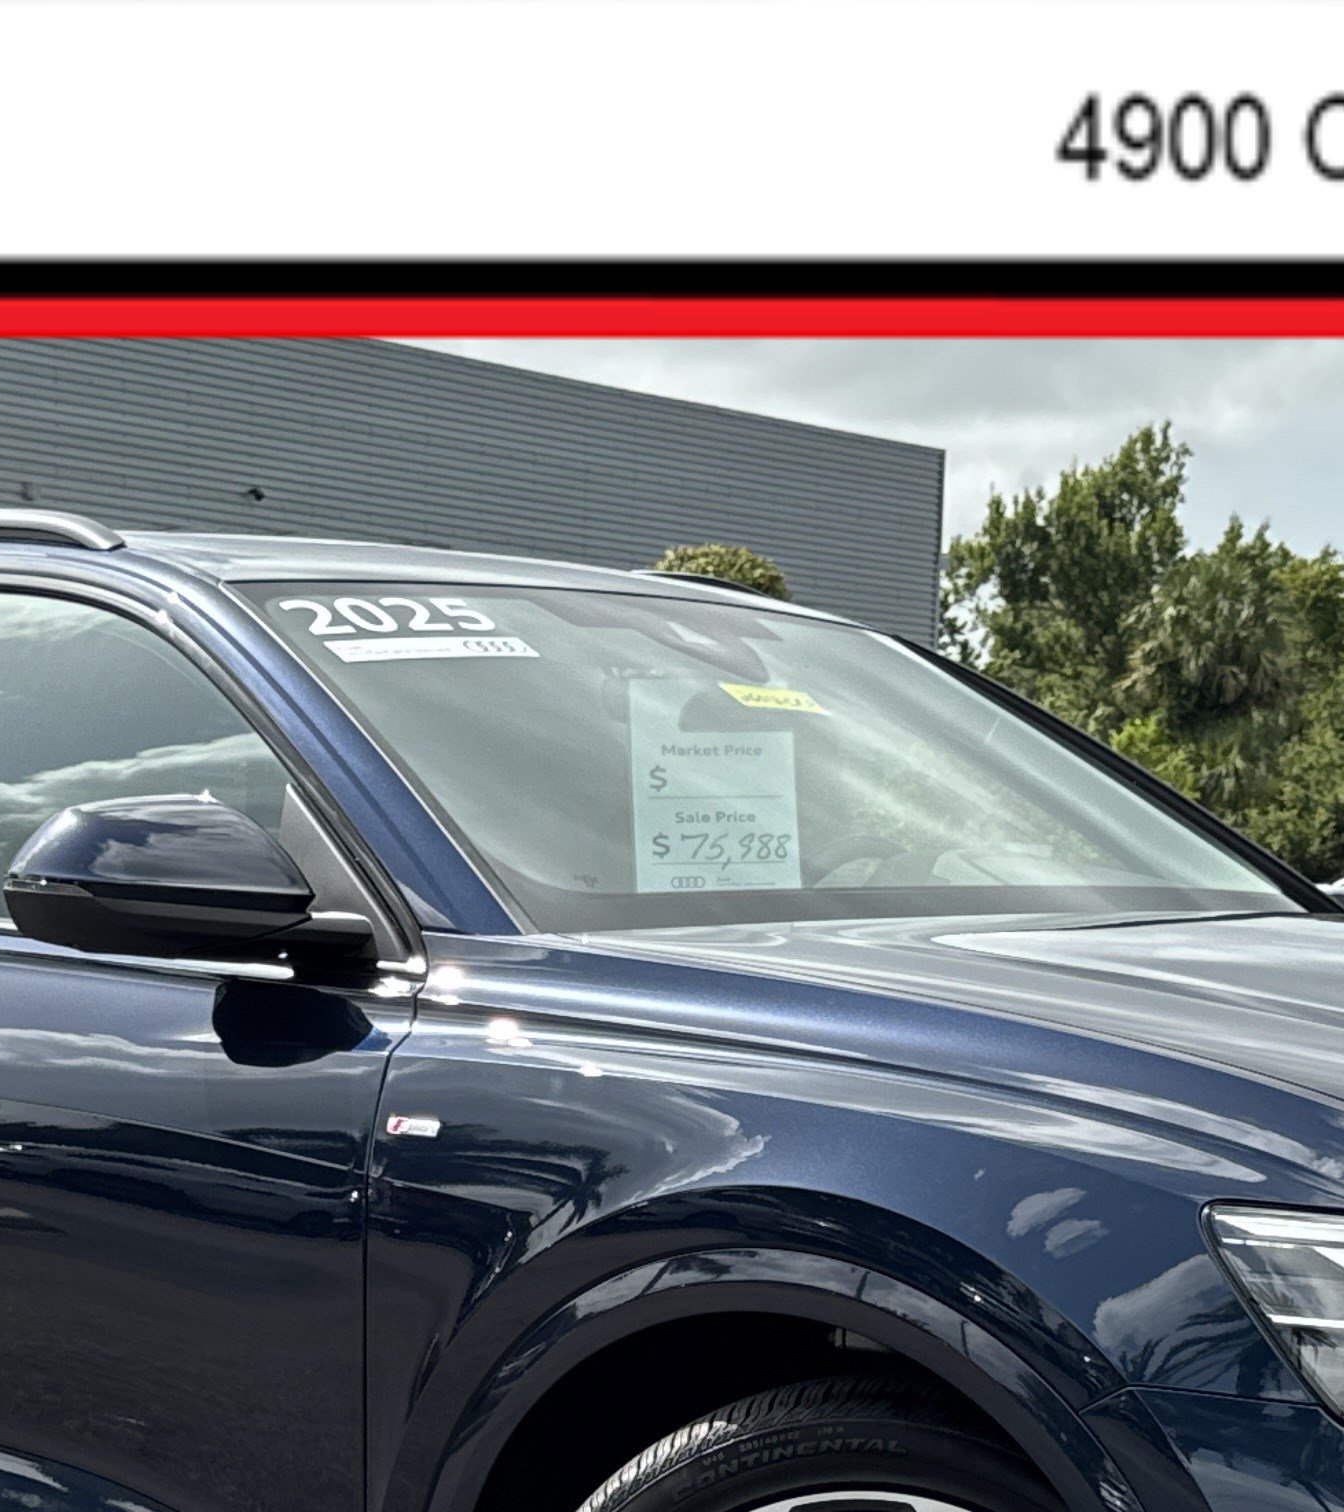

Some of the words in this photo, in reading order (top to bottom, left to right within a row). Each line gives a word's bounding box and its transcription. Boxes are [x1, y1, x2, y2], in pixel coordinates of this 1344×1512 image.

[278, 597, 497, 636] 2025
[661, 744, 719, 757] Market
[724, 744, 763, 756] Price
[649, 765, 668, 792] $
[675, 811, 711, 824] Sale
[715, 811, 757, 823] Price
